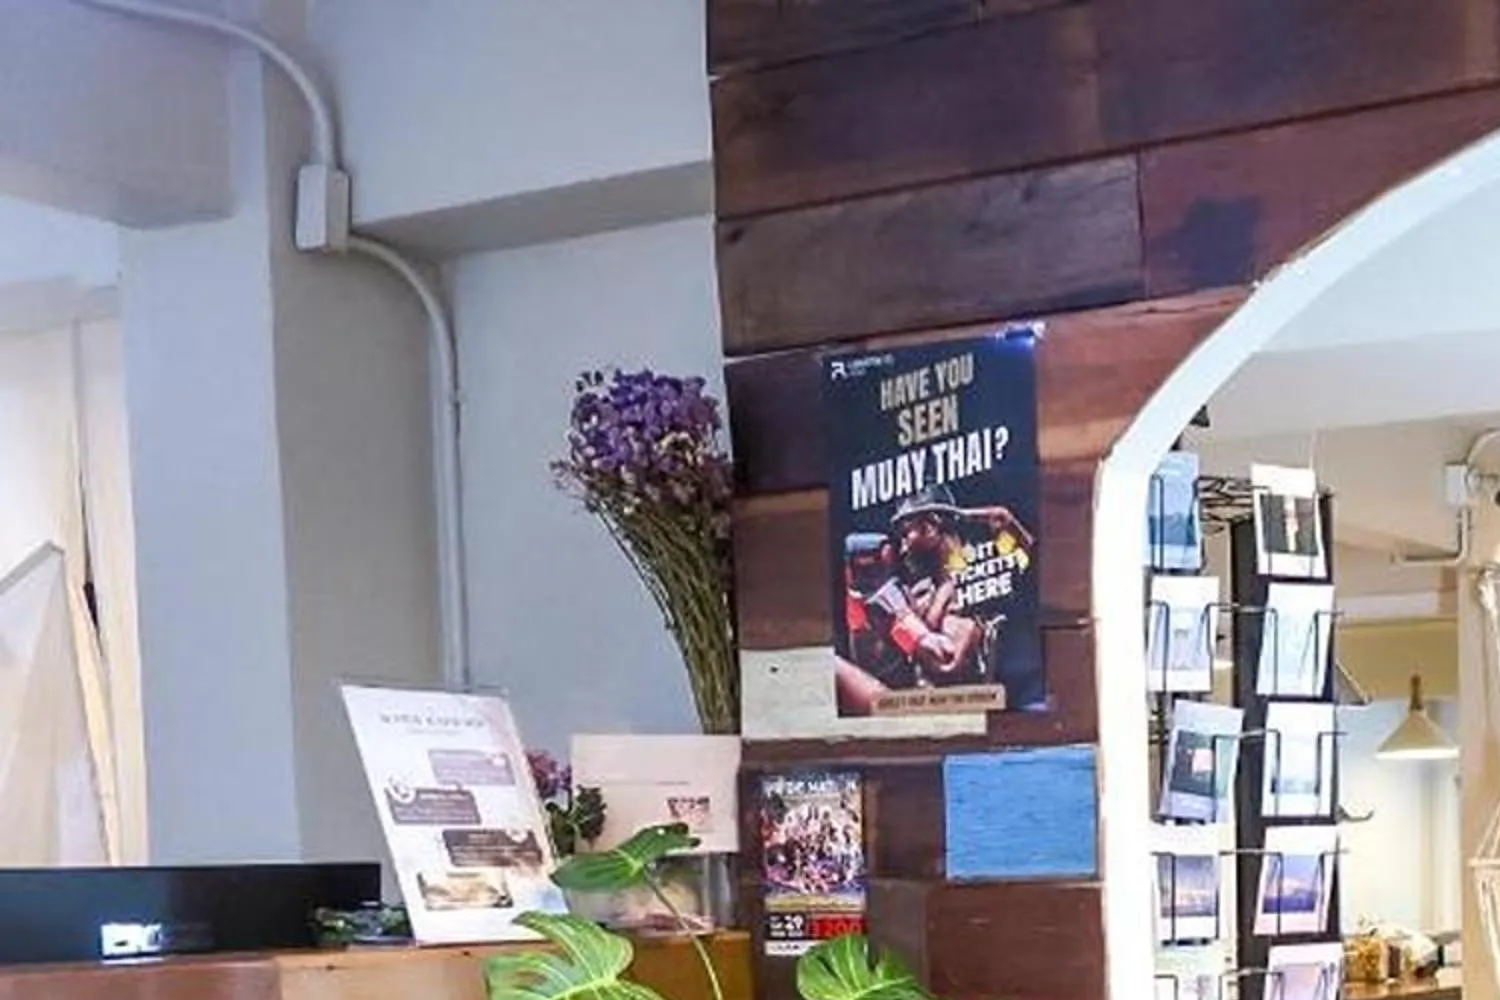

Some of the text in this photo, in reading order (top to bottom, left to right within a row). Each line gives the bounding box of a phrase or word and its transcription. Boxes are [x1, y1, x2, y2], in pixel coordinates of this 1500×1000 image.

[880, 367, 930, 411] HAVE
[934, 353, 974, 393] YOU
[897, 394, 959, 446] SEEN
[851, 426, 1010, 510] MUAY THAI?
[957, 571, 1013, 607] HERE
